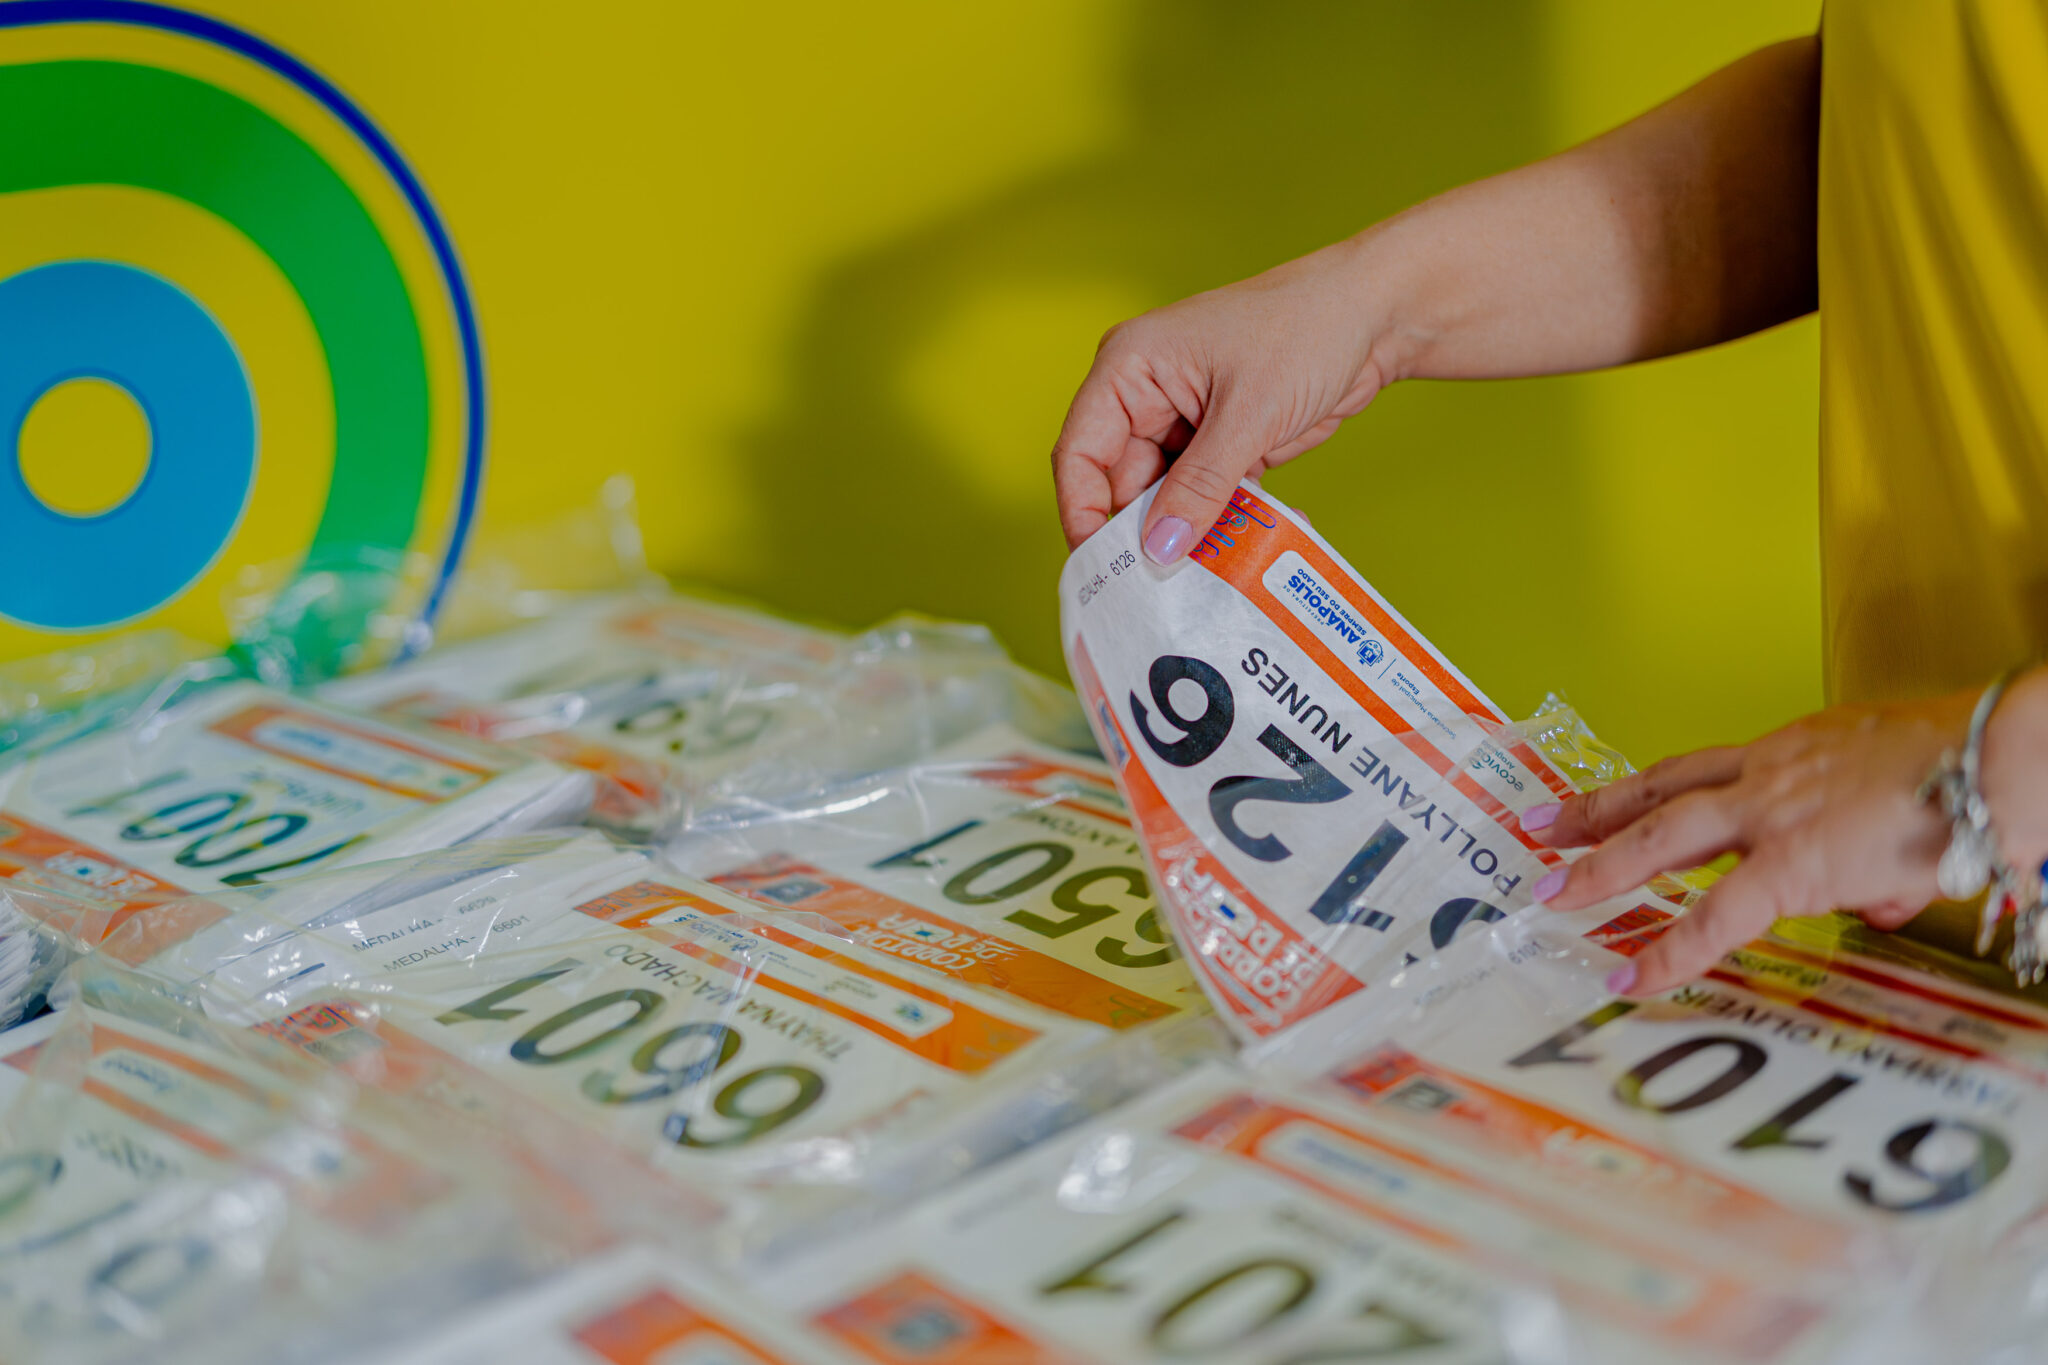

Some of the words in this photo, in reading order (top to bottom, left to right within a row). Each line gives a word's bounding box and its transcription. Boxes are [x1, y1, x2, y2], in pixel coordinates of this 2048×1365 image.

[1110, 550, 1136, 576] 6126
[1297, 568, 1316, 587] LADO
[1315, 586, 1330, 600] SEU
[1329, 599, 1341, 610] DO
[1288, 575, 1361, 644] ANÁPOLIS
[1339, 609, 1367, 636] SEMPRE
[1391, 678, 1400, 687] de
[1396, 672, 1420, 695] Esporte
[1241, 647, 1352, 754] NUNES
[1399, 685, 1427, 714] Municipal
[1349, 746, 1522, 897] POLLYANE
[384, 936, 469, 973] MEDALHA
[492, 914, 531, 933] 6601
[434, 956, 827, 1150] 6601
[1505, 1002, 2012, 1211] 6101
